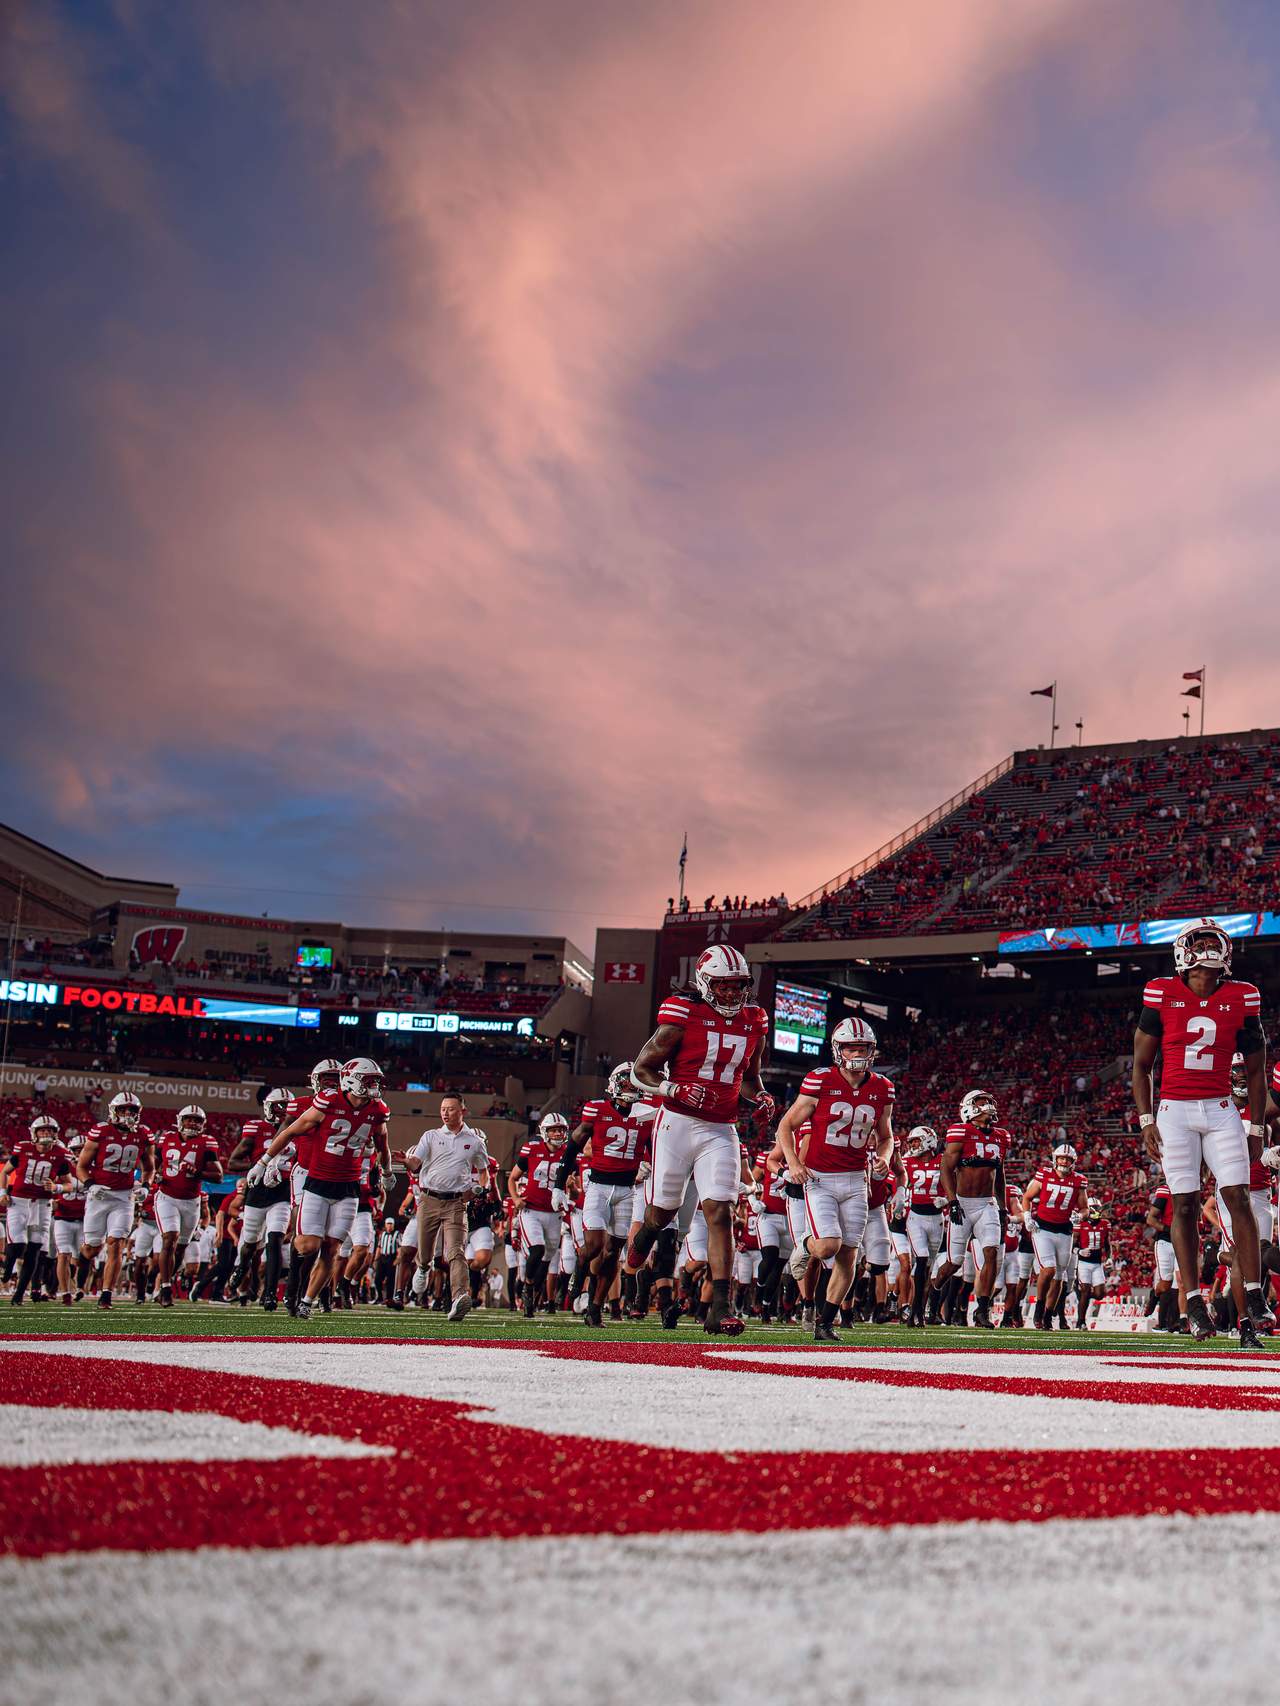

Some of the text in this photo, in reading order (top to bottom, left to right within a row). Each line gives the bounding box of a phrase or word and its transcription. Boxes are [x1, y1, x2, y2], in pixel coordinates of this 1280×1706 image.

[63, 986, 207, 1017] FOOTBALL
[338, 1015, 359, 1026] FAU
[383, 1017, 390, 1027] 3
[442, 1019, 454, 1029] 16
[459, 1020, 514, 1032] MICHIGAN ST
[698, 1031, 748, 1084] 17
[1183, 1016, 1217, 1070] 2
[117, 1078, 203, 1097] WISCONSIN
[207, 1085, 251, 1101] DELLS
[324, 1118, 373, 1158] 24
[824, 1101, 876, 1149] 28
[603, 1126, 639, 1160] 21
[24, 1159, 53, 1187] 10
[102, 1143, 140, 1174] 28
[165, 1148, 198, 1178] 34
[912, 1169, 941, 1195] 27
[1046, 1183, 1074, 1211] 77
